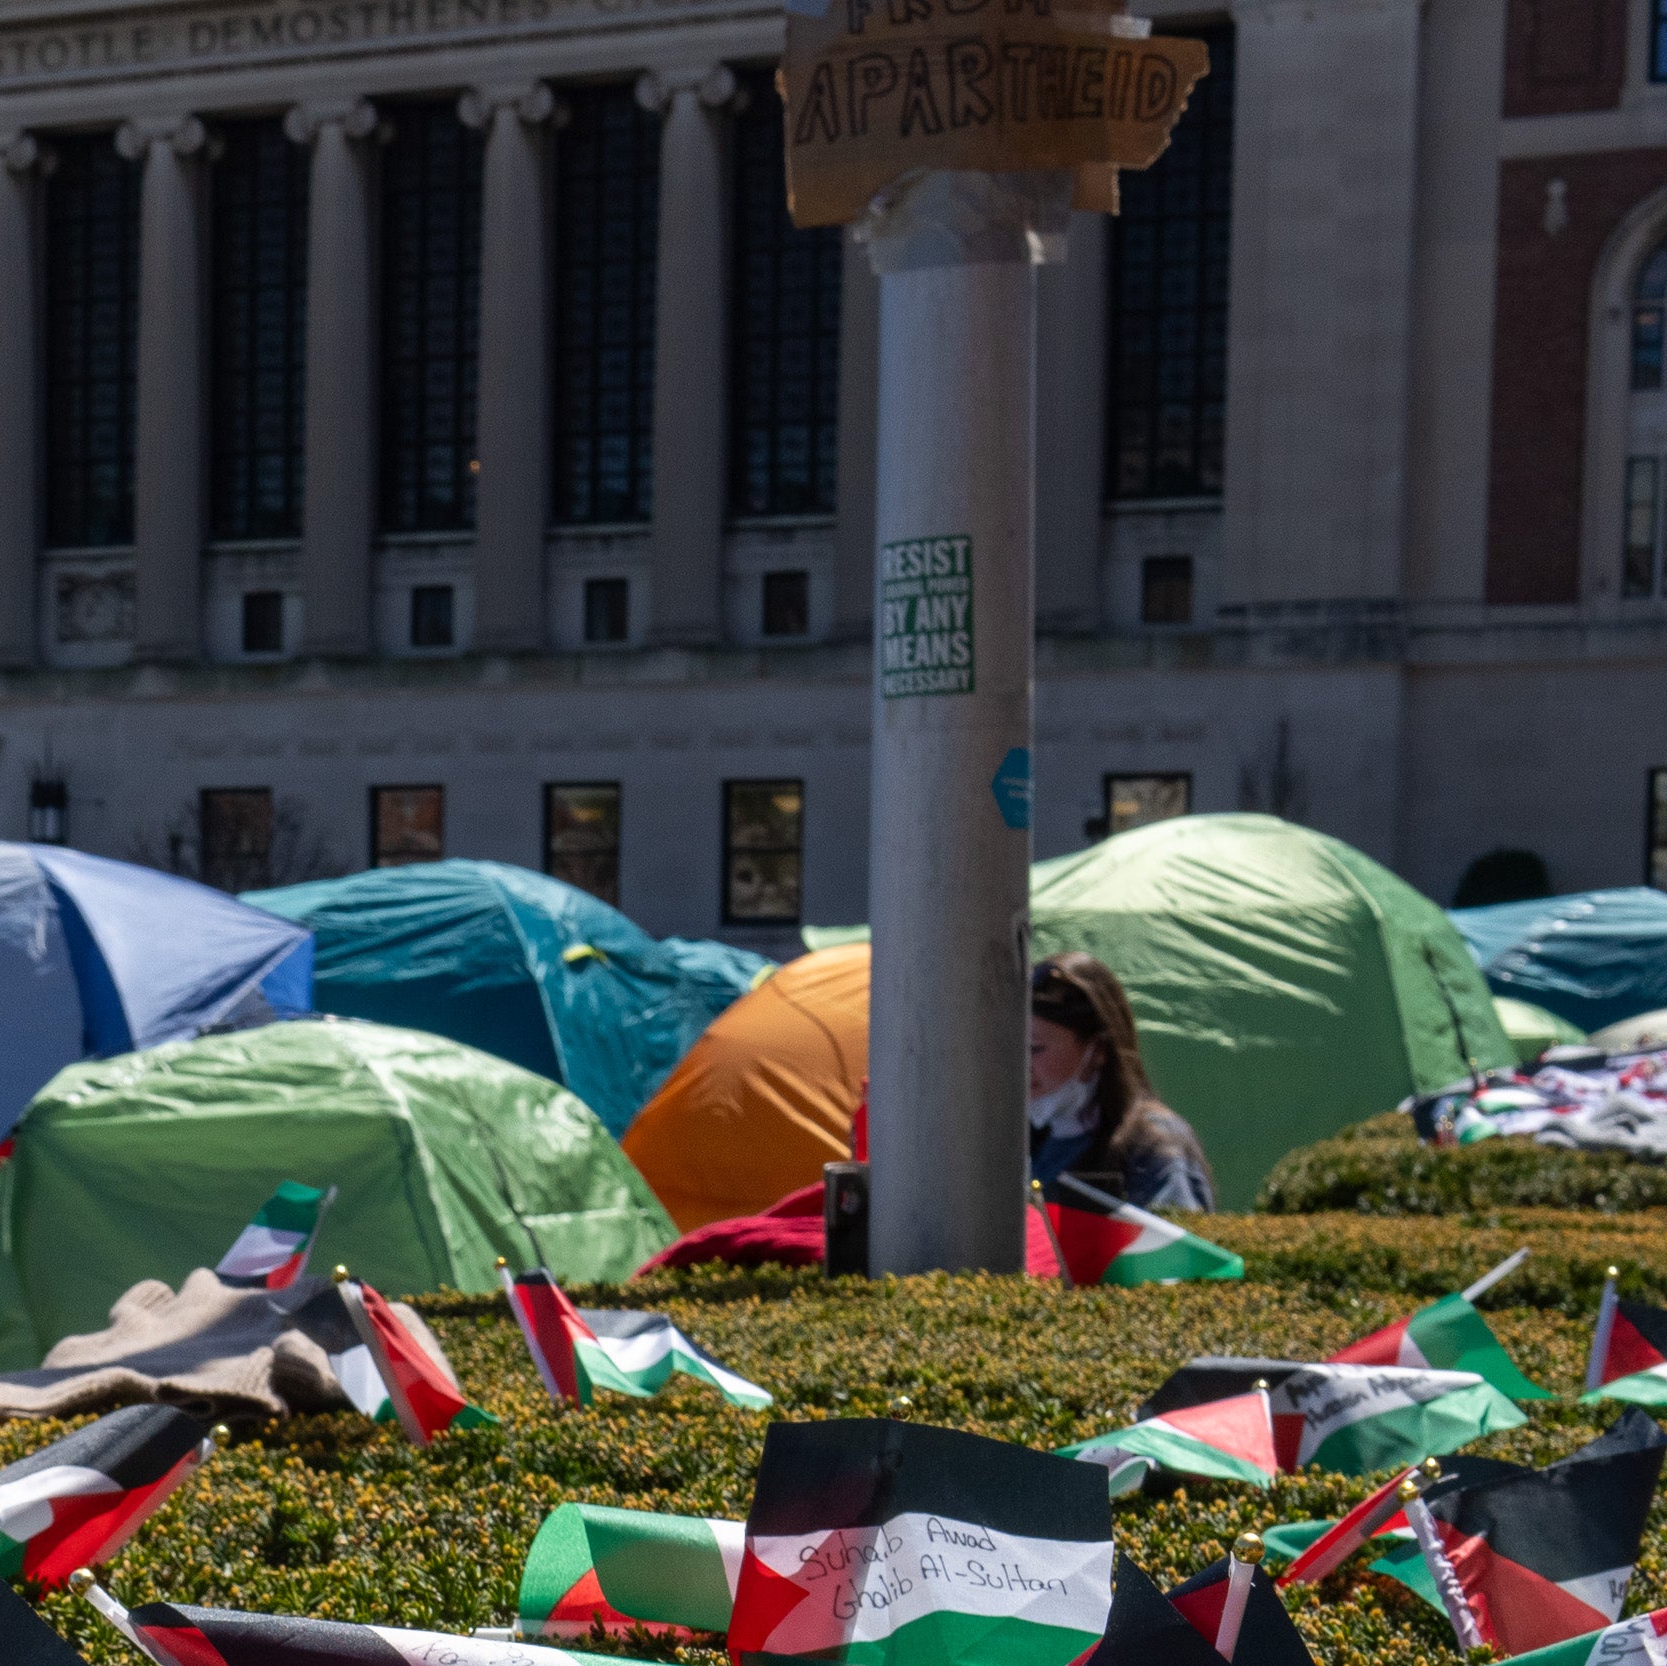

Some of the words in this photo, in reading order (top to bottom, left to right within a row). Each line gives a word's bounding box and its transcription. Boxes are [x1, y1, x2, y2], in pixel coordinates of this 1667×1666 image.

[795, 40, 1178, 147] APARTHEID
[881, 540, 970, 581] RESIST
[883, 599, 909, 634] BY
[914, 594, 970, 631] ANY
[883, 632, 971, 670] MEANS
[926, 1517, 997, 1551] Awad
[832, 1567, 913, 1620] Ghalib
[919, 1554, 1068, 1596] Al-Sultan
